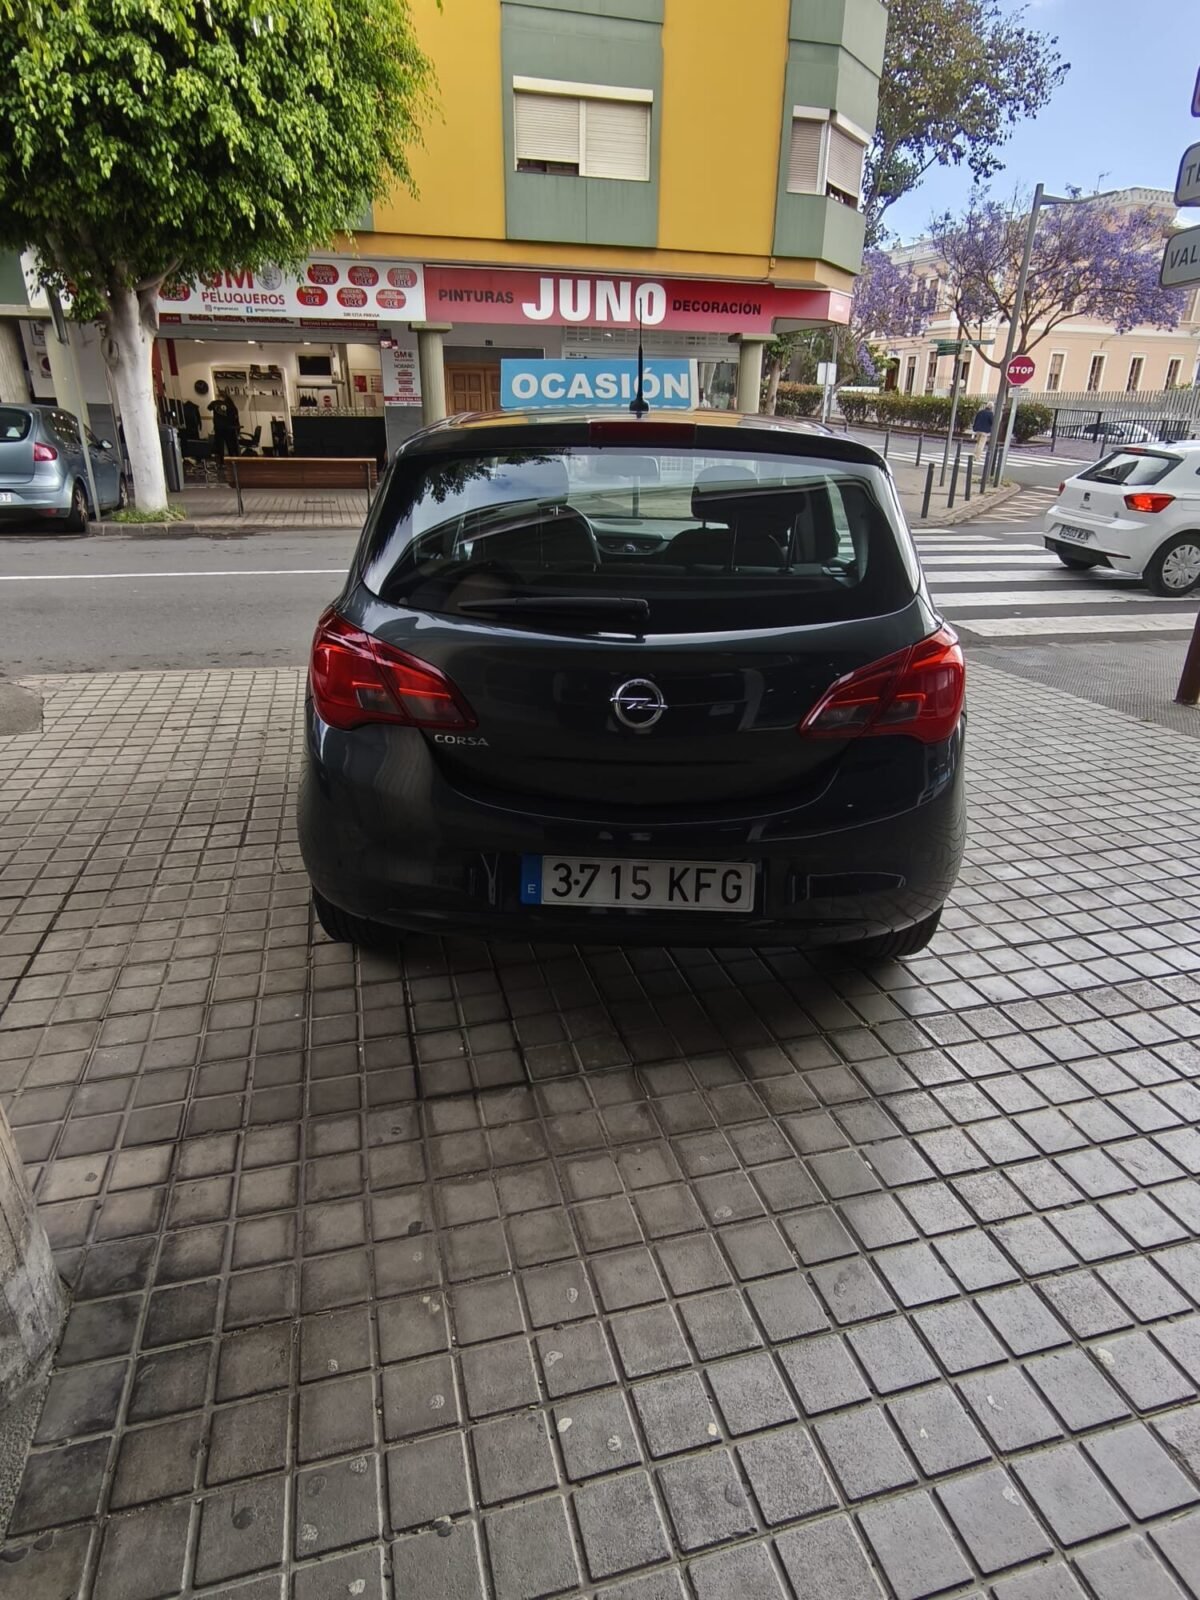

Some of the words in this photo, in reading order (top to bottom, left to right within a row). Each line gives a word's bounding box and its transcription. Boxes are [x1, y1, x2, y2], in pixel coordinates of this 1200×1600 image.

[1170, 245, 1200, 269] VAL
[201, 291, 285, 306] PELUQUEROS
[438, 289, 514, 304] PINTURAS
[522, 278, 666, 325] JUNO
[672, 300, 762, 316] DECORACIÓN
[1008, 366, 1034, 375] STOP
[511, 367, 689, 399] OCASIÓN
[434, 734, 489, 746] CORSA
[527, 883, 536, 894] E
[551, 862, 652, 901] 3715
[667, 866, 742, 904] KFG
